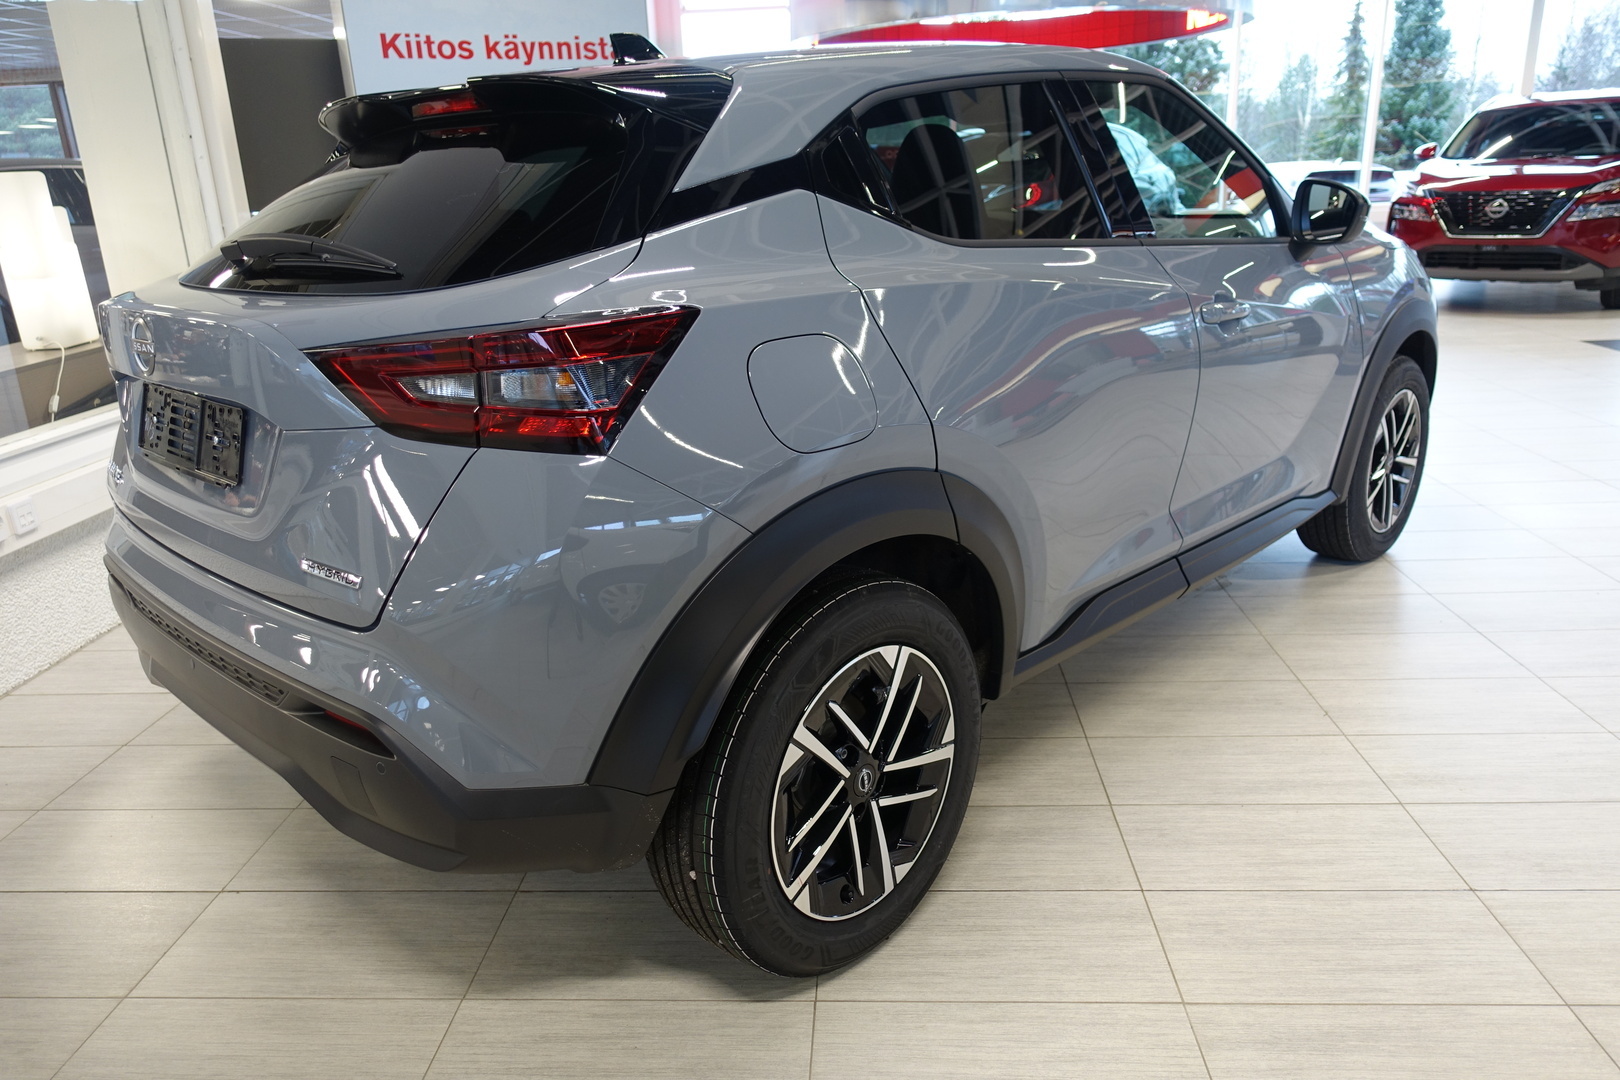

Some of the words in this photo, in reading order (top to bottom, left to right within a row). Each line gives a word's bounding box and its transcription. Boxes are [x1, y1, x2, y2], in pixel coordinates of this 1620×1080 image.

[379, 33, 474, 60] Kiitos
[484, 34, 615, 66] käynnist
[304, 560, 356, 586] HYBRID
